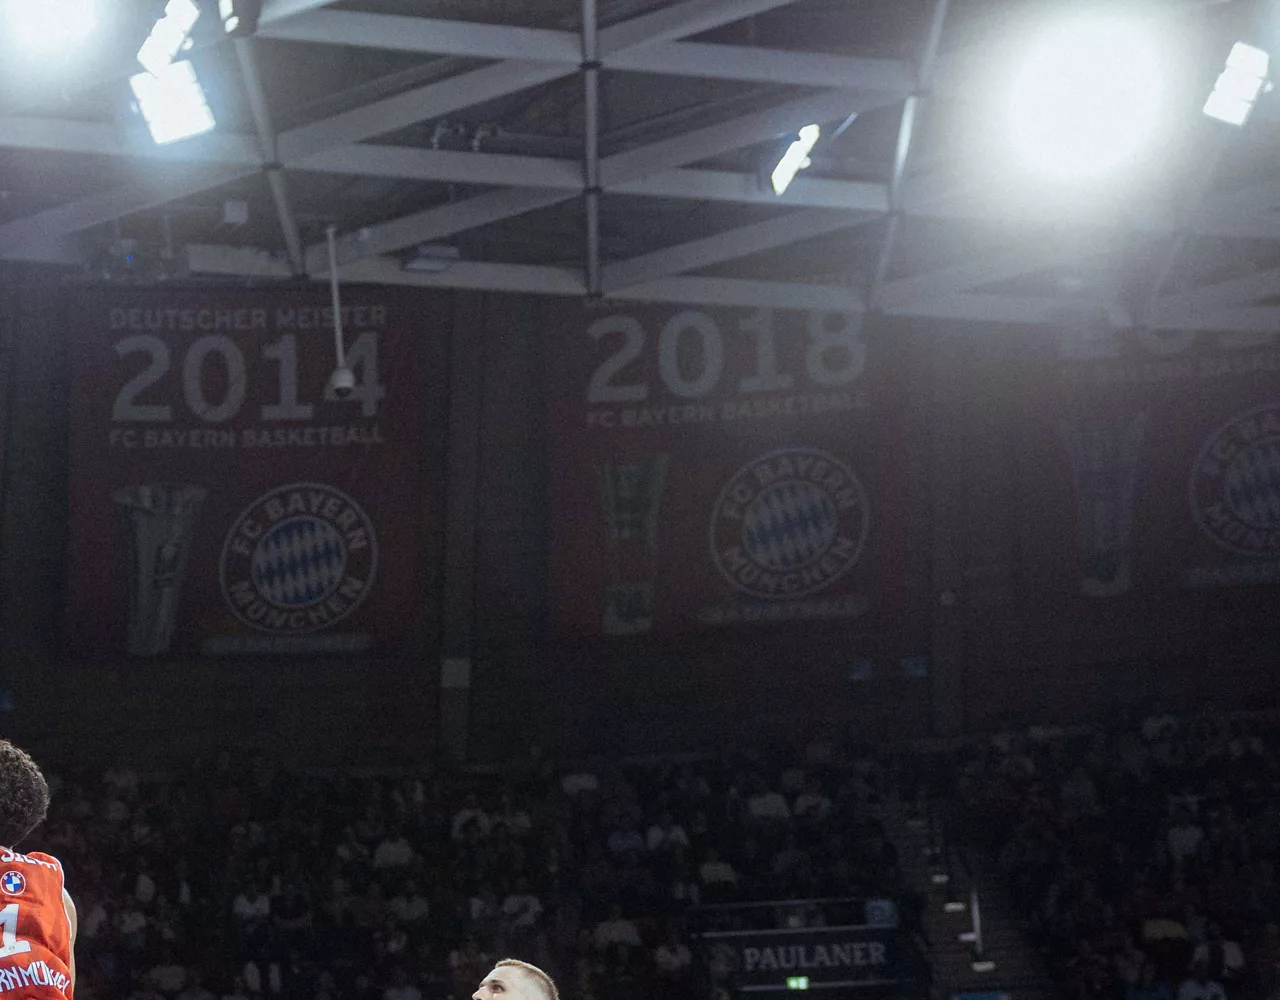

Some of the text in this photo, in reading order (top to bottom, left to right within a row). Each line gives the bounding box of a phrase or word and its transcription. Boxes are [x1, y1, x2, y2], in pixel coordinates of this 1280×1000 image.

[109, 305, 387, 330] DEUTSCHER MEISTER
[586, 308, 867, 404] 2018
[110, 332, 387, 423] 2014
[109, 426, 386, 448] FC BAYERN BASKETBALL
[586, 410, 616, 429] FC
[621, 404, 716, 428] BAYERN
[752, 456, 857, 510] BAYERN
[231, 491, 369, 557] FC BAYERN
[743, 941, 887, 972] PAULANER
